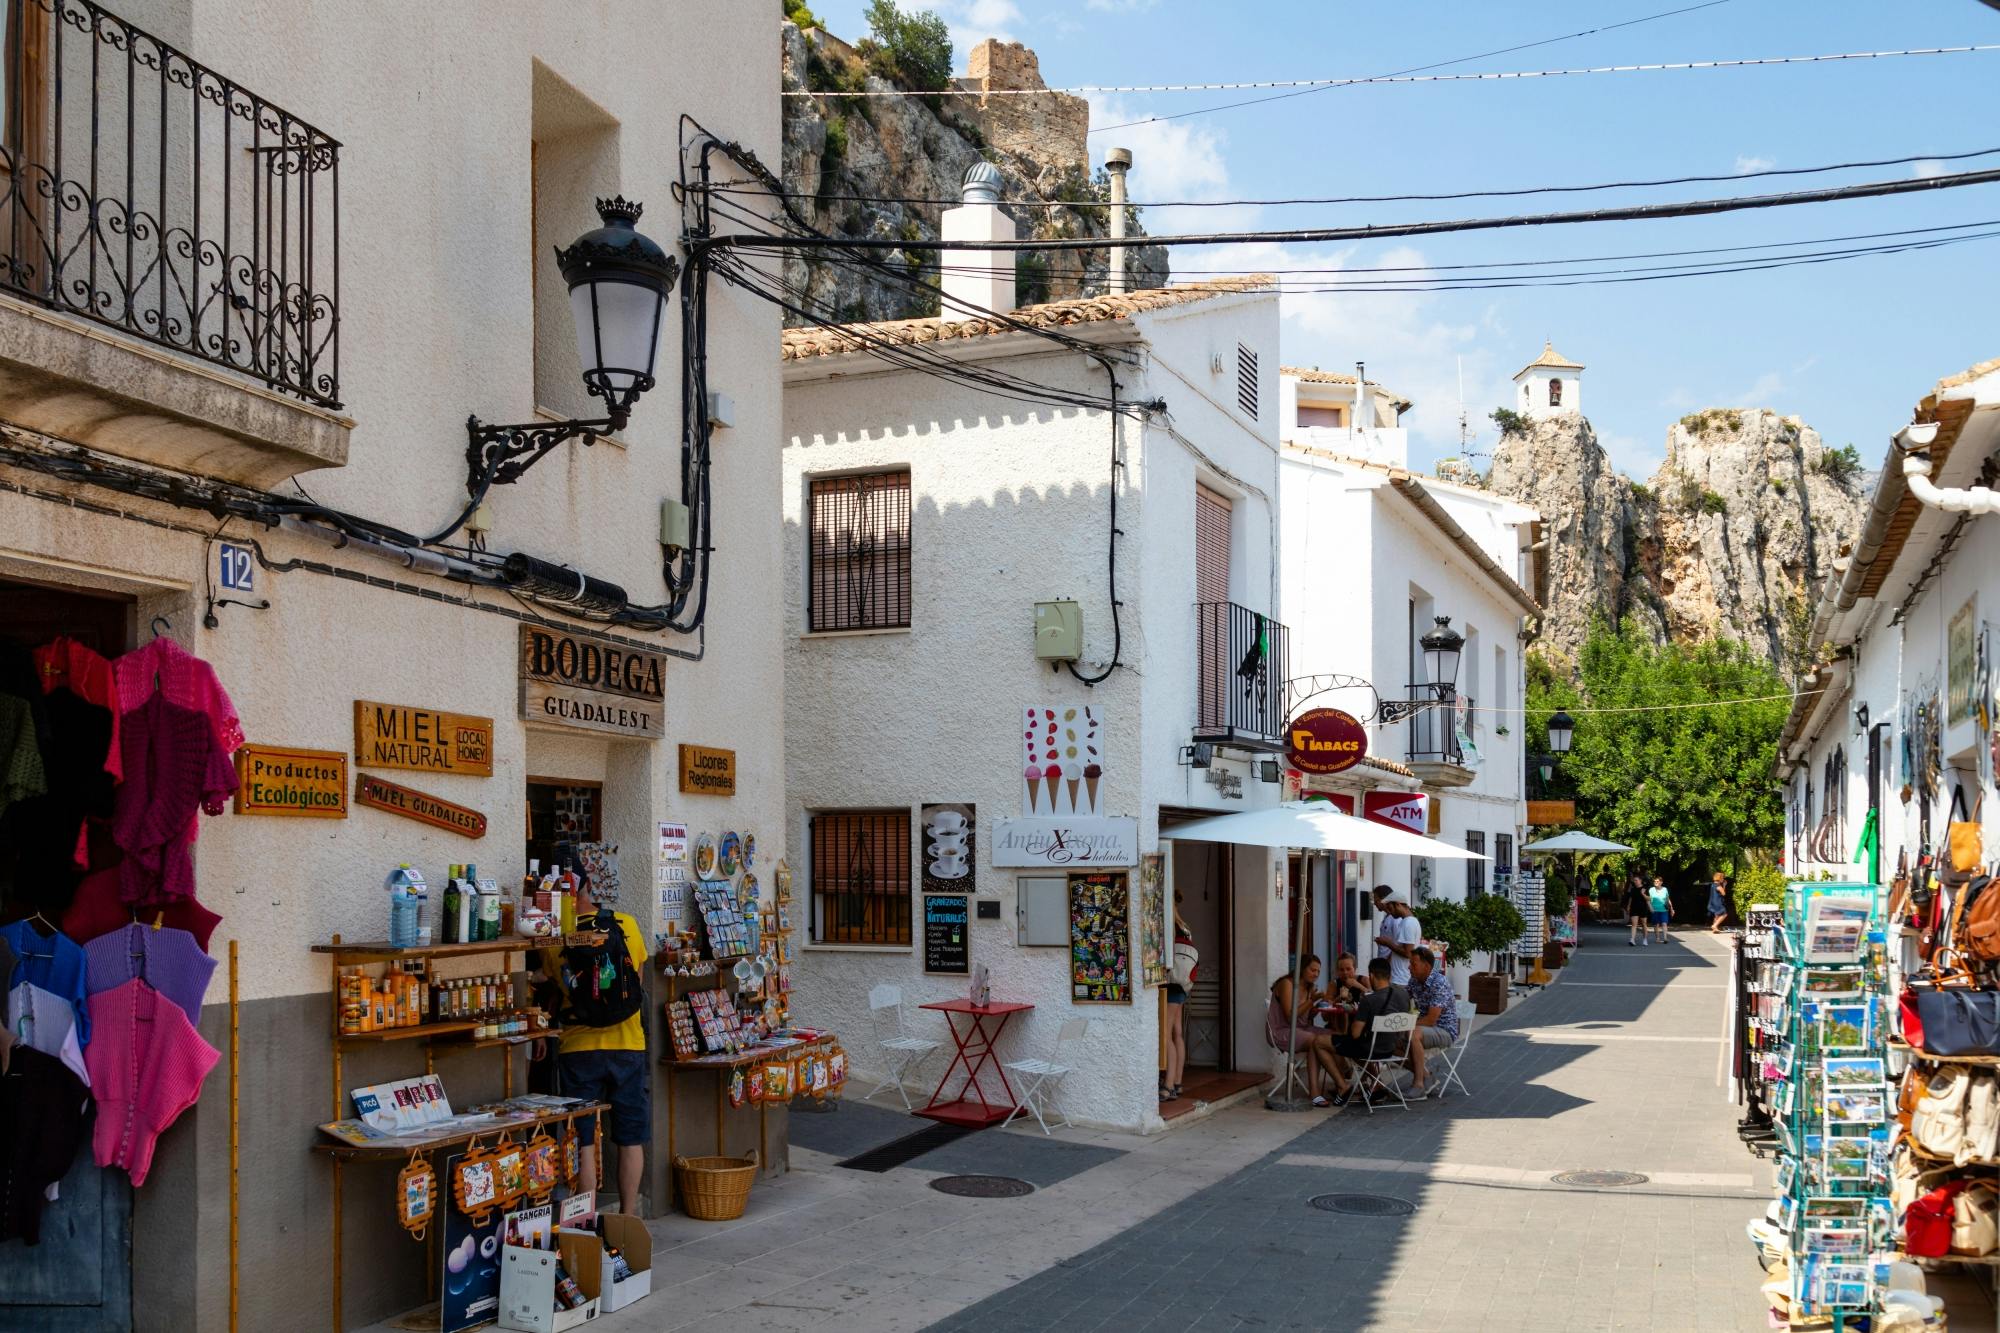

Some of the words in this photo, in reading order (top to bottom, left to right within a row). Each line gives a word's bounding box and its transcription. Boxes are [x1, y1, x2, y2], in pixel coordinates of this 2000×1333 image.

[222, 548, 252, 589] 12
[531, 631, 664, 697] BODEGA
[543, 695, 650, 730] GUADALEST
[376, 707, 449, 746] MIEL
[458, 730, 486, 747] LOCAL
[1292, 730, 1359, 751] TABACS
[374, 743, 453, 768] NATURAL
[458, 745, 486, 761] HONEY
[693, 750, 728, 771] Licores
[255, 760, 338, 780] Productos
[688, 770, 733, 789] Regionales
[253, 783, 340, 809] Ecológicos
[371, 784, 406, 808] MIEL
[412, 798, 478, 830] GUADALEST
[1390, 806, 1422, 820] ATM
[1090, 850, 1129, 862] helados
[660, 868, 685, 881] JALEA
[662, 889, 683, 902] REAL
[927, 912, 967, 924] NATURALES
[518, 1206, 551, 1222] SANGRIA
